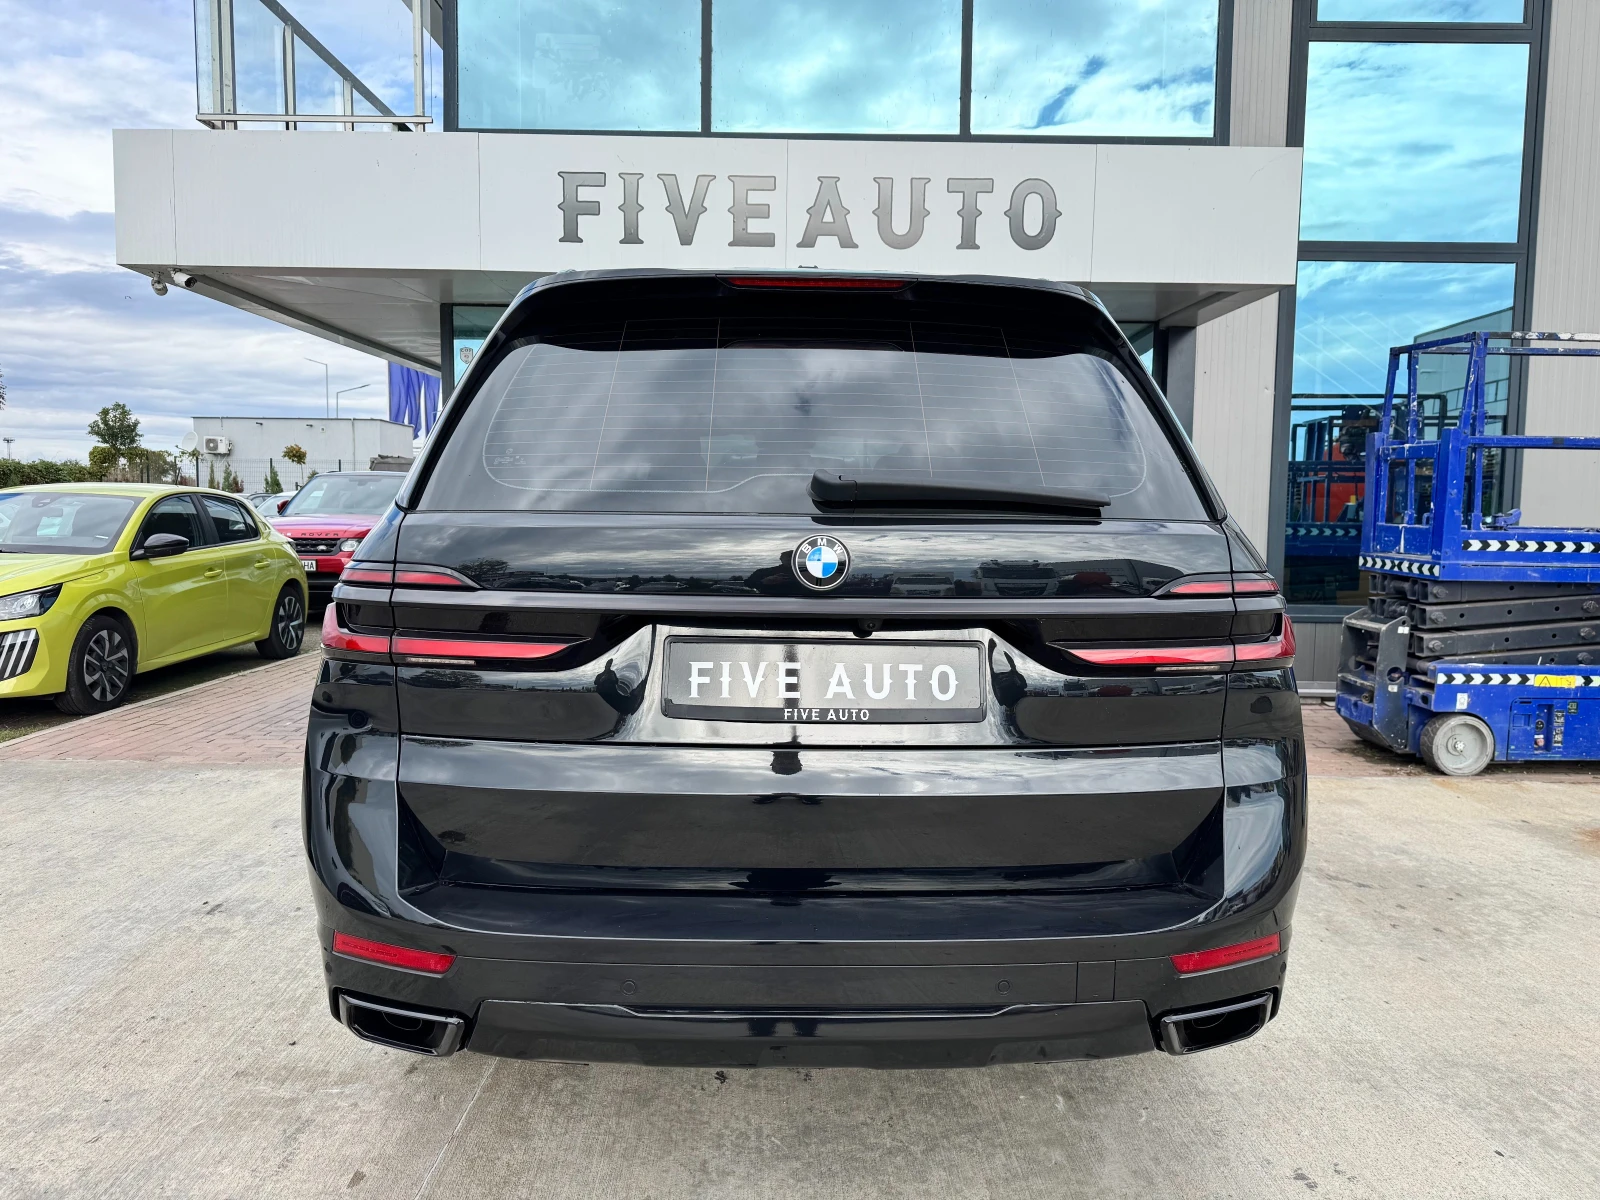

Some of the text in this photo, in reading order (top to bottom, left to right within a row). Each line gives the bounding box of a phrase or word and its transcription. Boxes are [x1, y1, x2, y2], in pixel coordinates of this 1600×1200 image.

[801, 538, 843, 554] BMW
[688, 661, 959, 701] FIVE AUTO
[783, 708, 870, 721] FIVE AUTO
